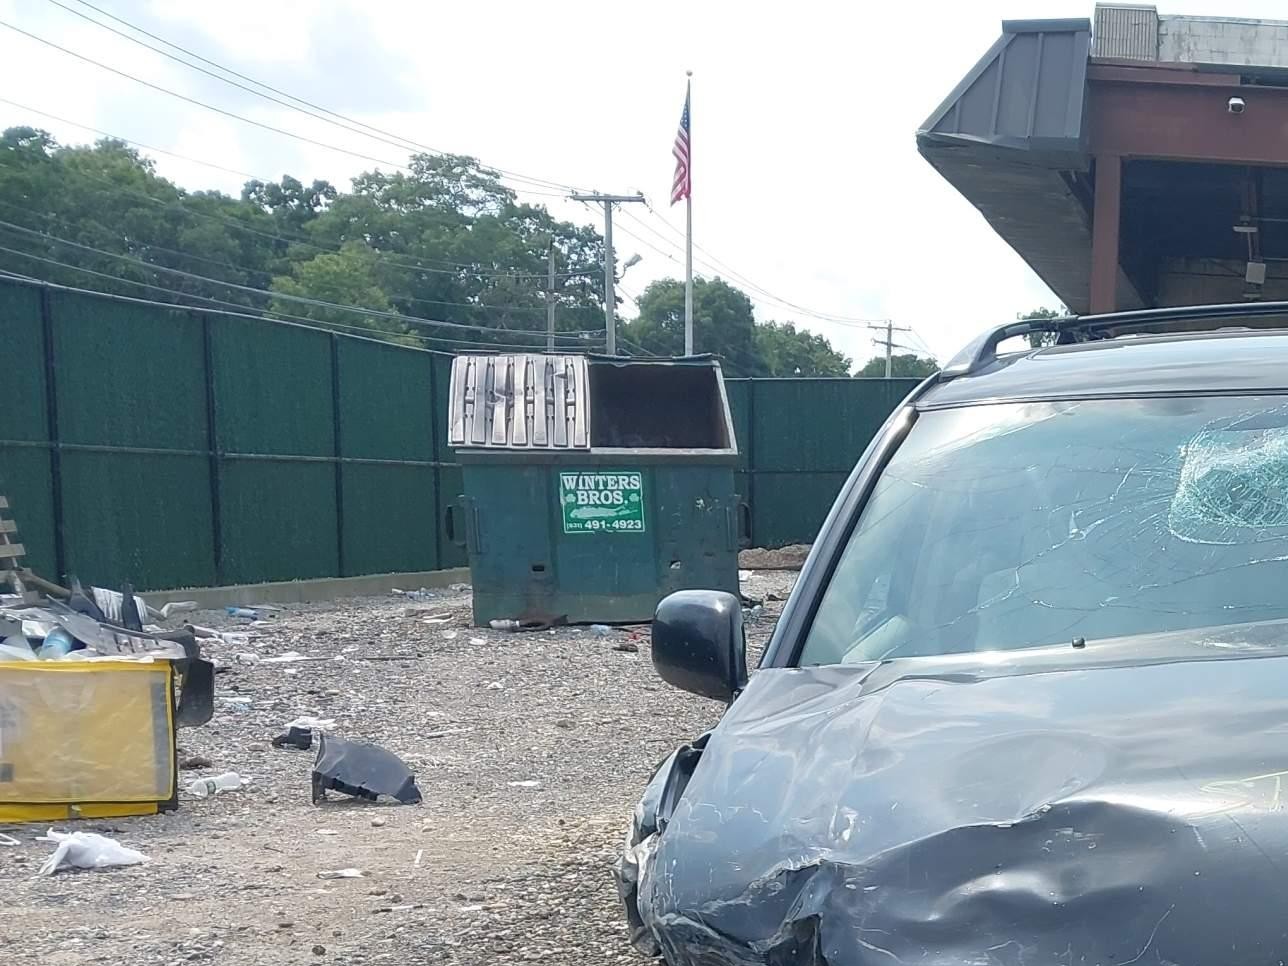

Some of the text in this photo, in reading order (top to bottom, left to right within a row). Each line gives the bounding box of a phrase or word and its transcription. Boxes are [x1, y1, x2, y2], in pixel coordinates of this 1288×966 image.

[562, 475, 640, 490] WINTERS
[576, 490, 628, 505] BROS.
[584, 519, 642, 529] 491-4923
